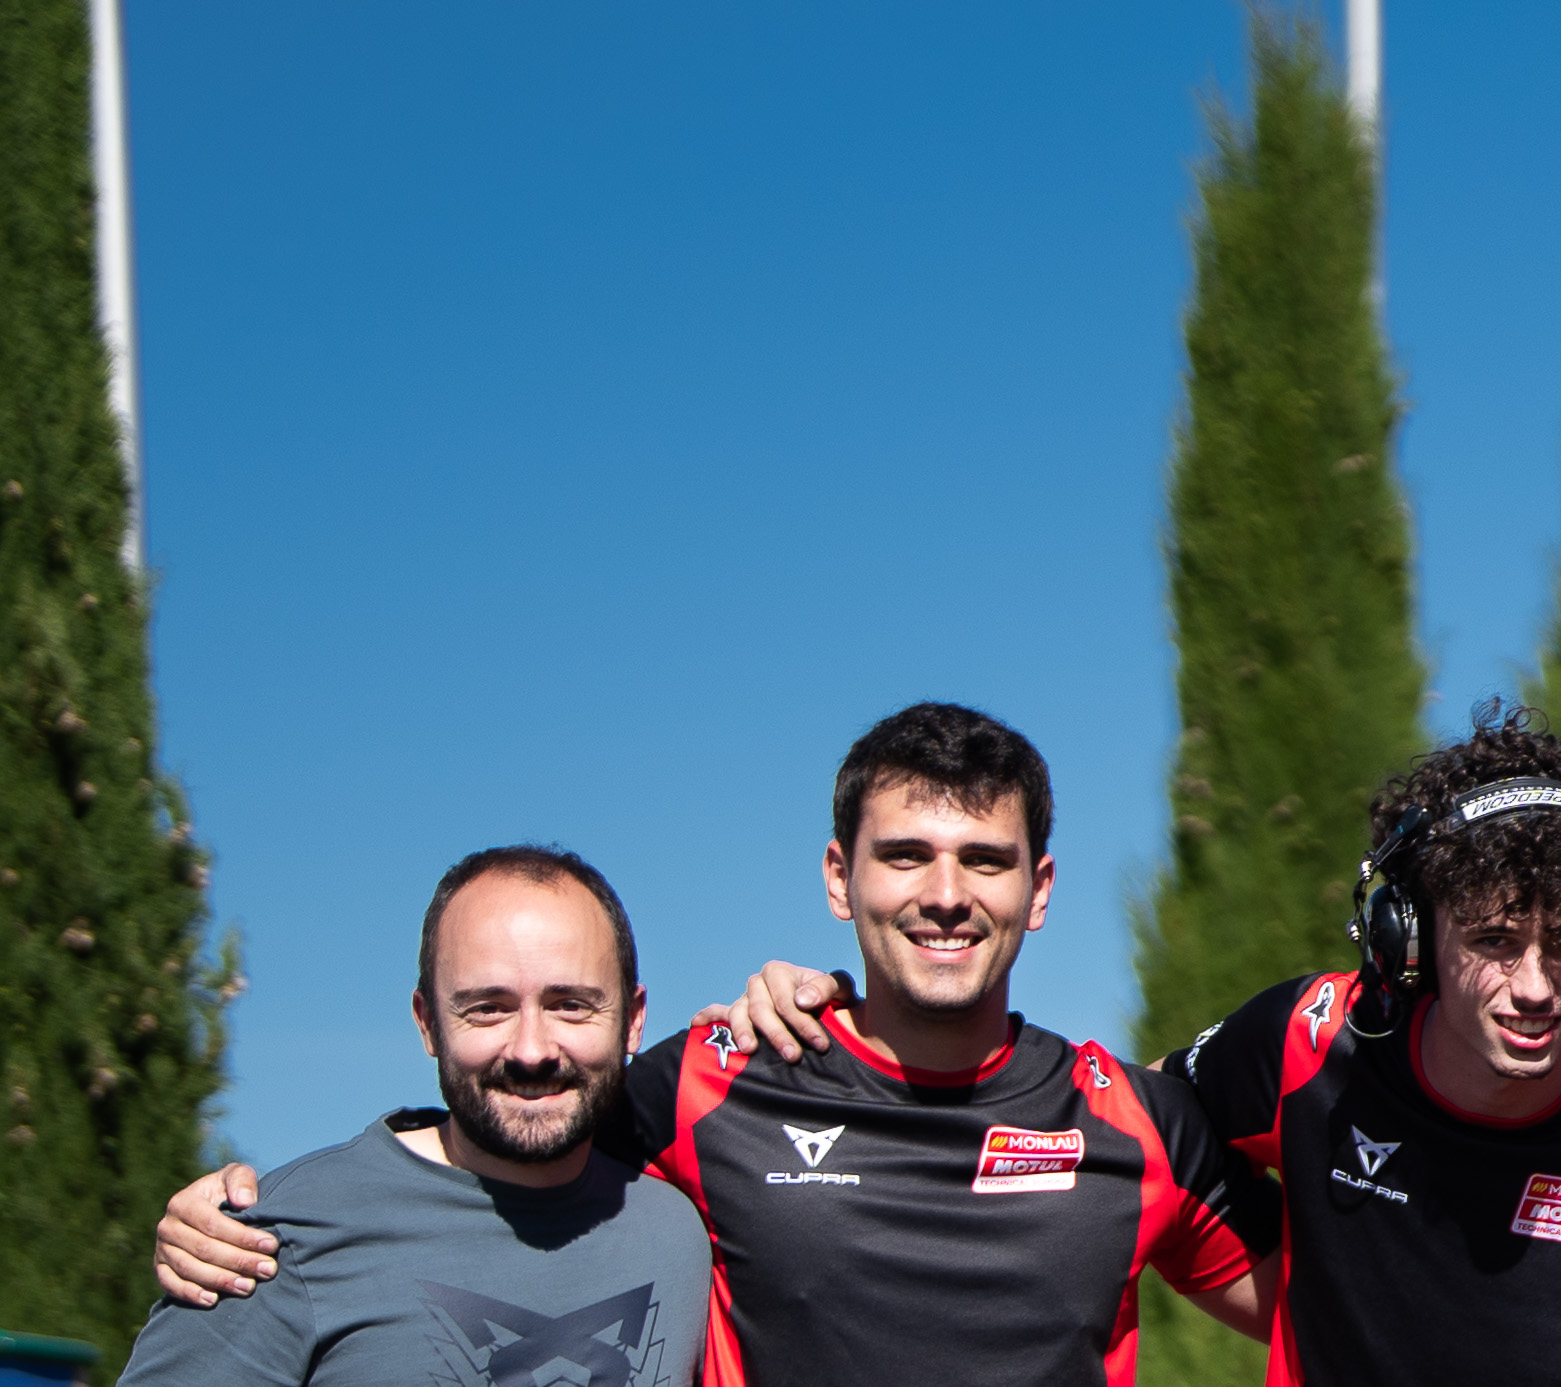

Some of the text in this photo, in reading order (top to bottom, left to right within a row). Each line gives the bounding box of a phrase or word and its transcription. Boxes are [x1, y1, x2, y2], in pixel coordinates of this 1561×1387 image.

[1008, 1135, 1078, 1151] MONLAU
[992, 1159, 1064, 1174] MOTUL
[765, 1171, 860, 1186] CUPRA
[1330, 1168, 1409, 1204] CUPRA
